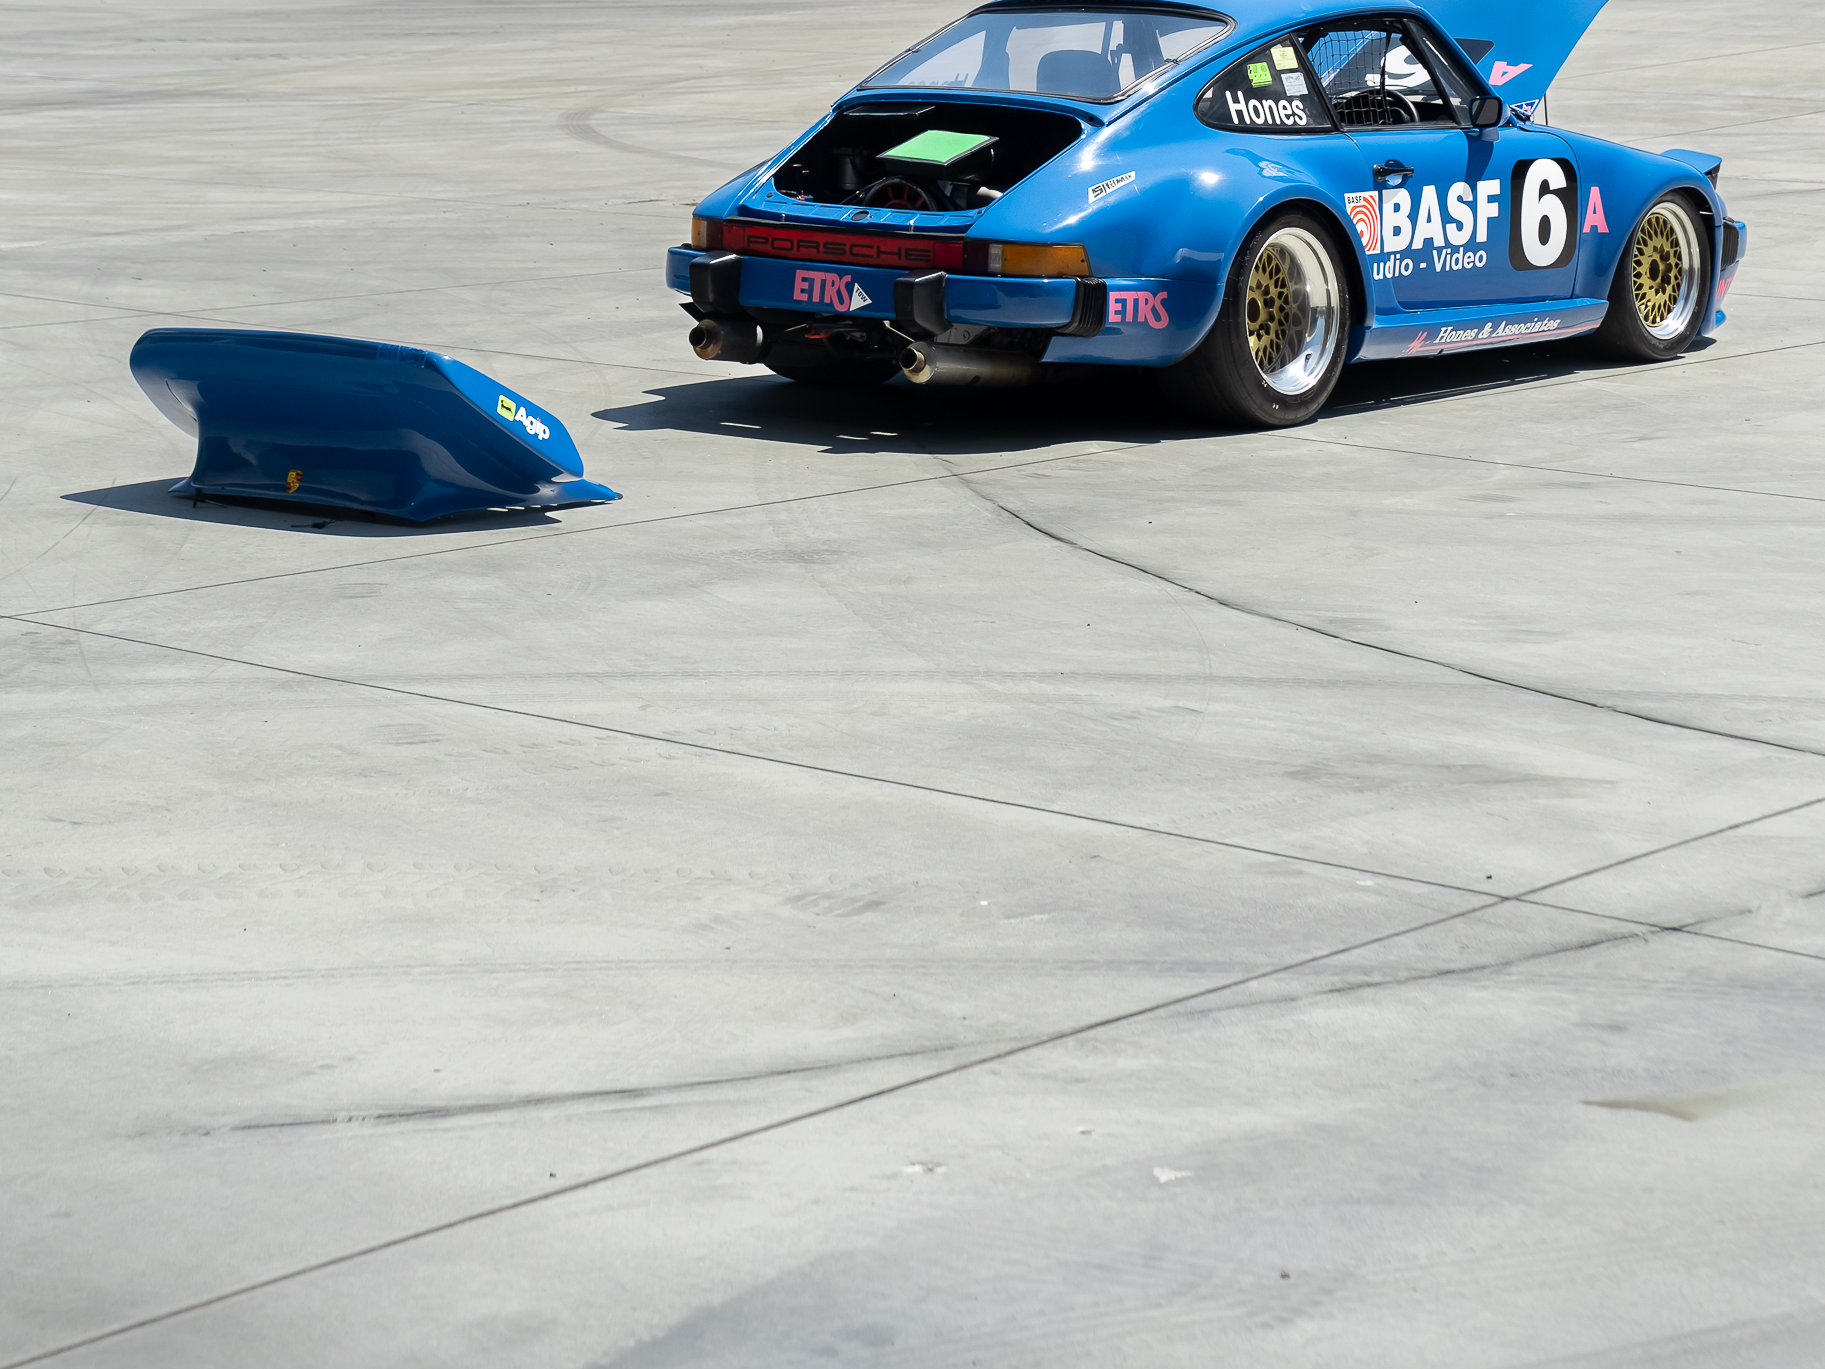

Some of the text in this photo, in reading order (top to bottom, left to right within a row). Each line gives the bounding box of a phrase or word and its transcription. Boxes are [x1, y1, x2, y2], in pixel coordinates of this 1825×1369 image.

[1488, 61, 1533, 86] A
[1225, 90, 1307, 126] Hones
[1347, 195, 1362, 205] BASF
[1382, 179, 1500, 253] BASF
[1521, 158, 1567, 267] 6
[1582, 186, 1609, 233] A
[747, 235, 931, 262] PORSCHE
[1432, 247, 1487, 272] Video
[793, 269, 852, 312] ETRS
[855, 287, 868, 303] TOW
[1109, 291, 1169, 329] ETRS
[1433, 317, 1561, 343] Hones & Associates
[514, 406, 550, 440] Agip
